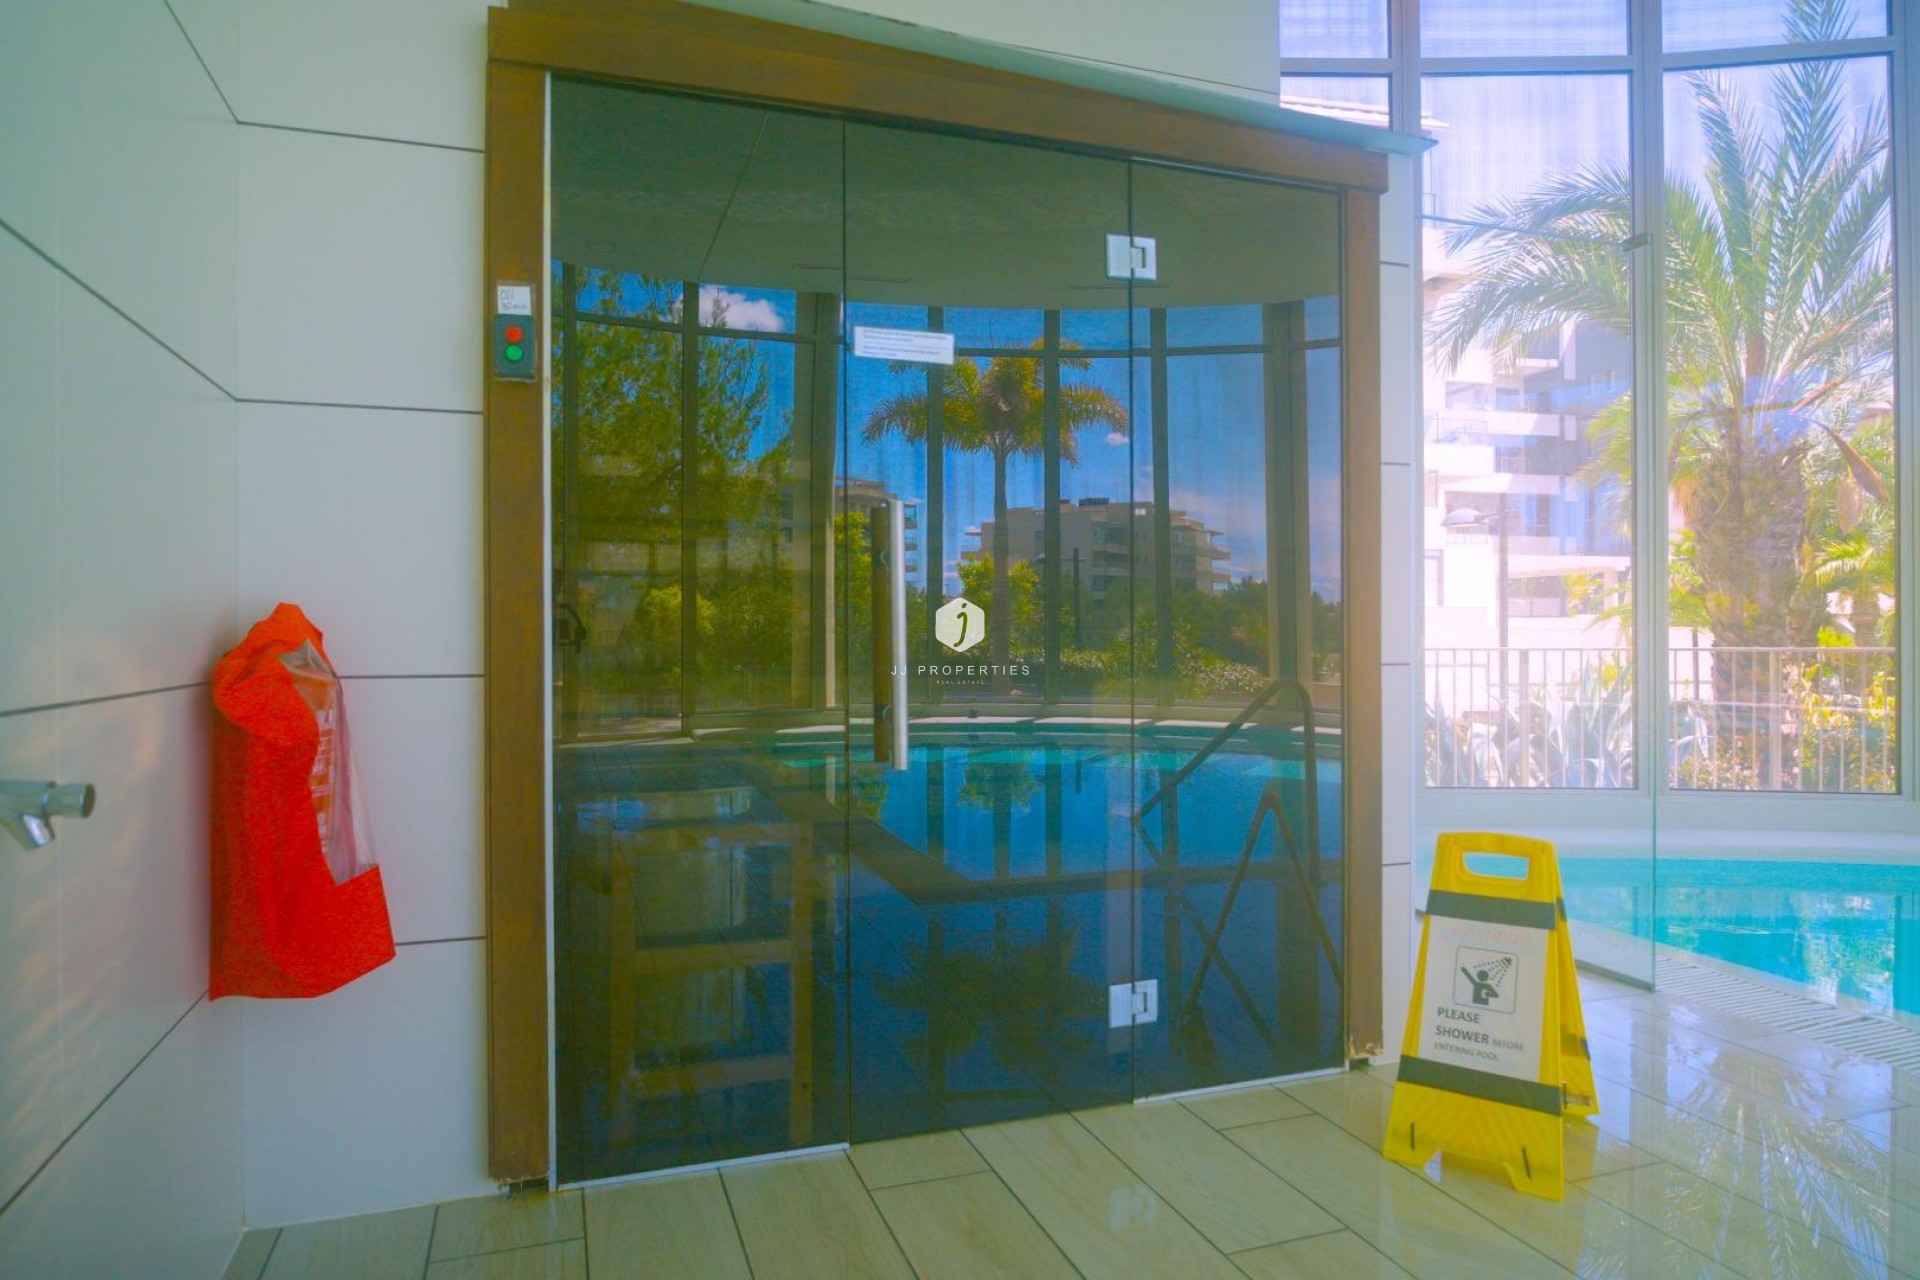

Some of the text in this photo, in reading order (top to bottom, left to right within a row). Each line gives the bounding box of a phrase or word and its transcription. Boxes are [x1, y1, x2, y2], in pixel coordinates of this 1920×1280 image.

[1437, 1007, 1481, 1024] PLEASE
[1434, 1025, 1525, 1051] SHOWER BEFORE
[1434, 1041, 1499, 1062] ENTERING POOL
